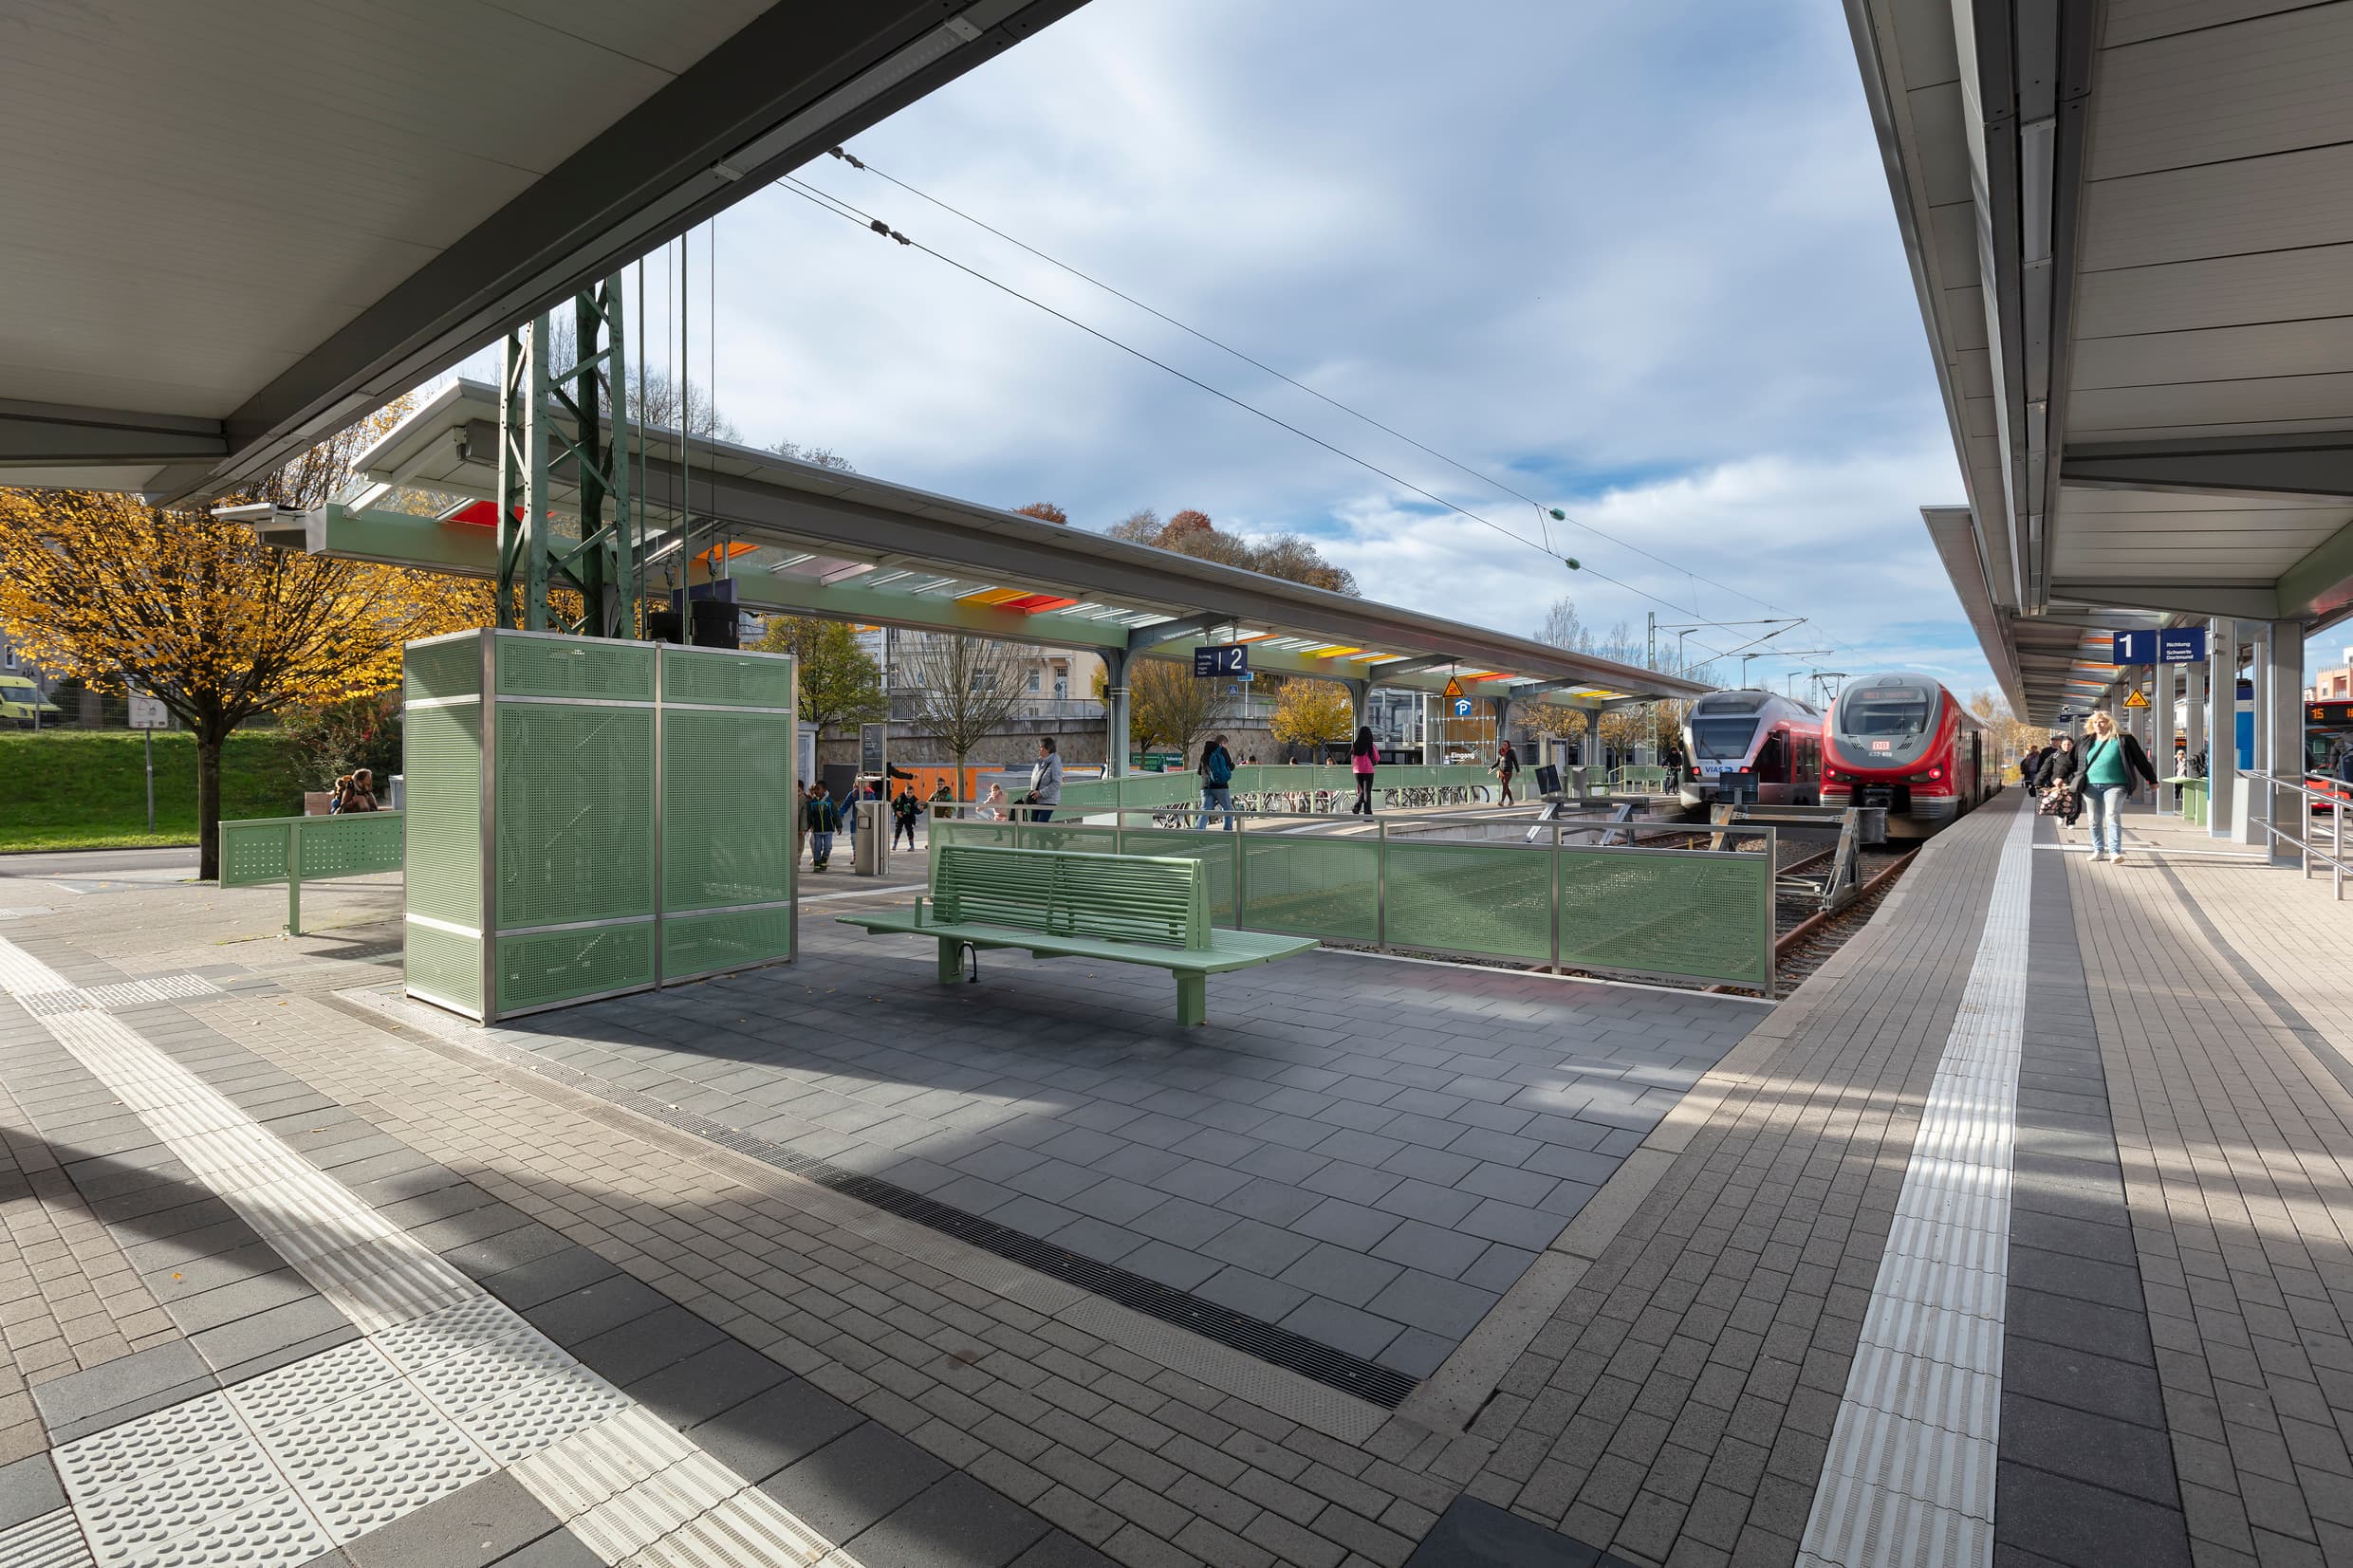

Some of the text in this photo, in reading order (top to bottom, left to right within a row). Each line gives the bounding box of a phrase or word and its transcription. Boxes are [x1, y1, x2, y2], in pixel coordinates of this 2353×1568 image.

[2119, 634, 2132, 658] 1
[1231, 648, 1242, 670] 2
[2311, 708, 2324, 719] 15
